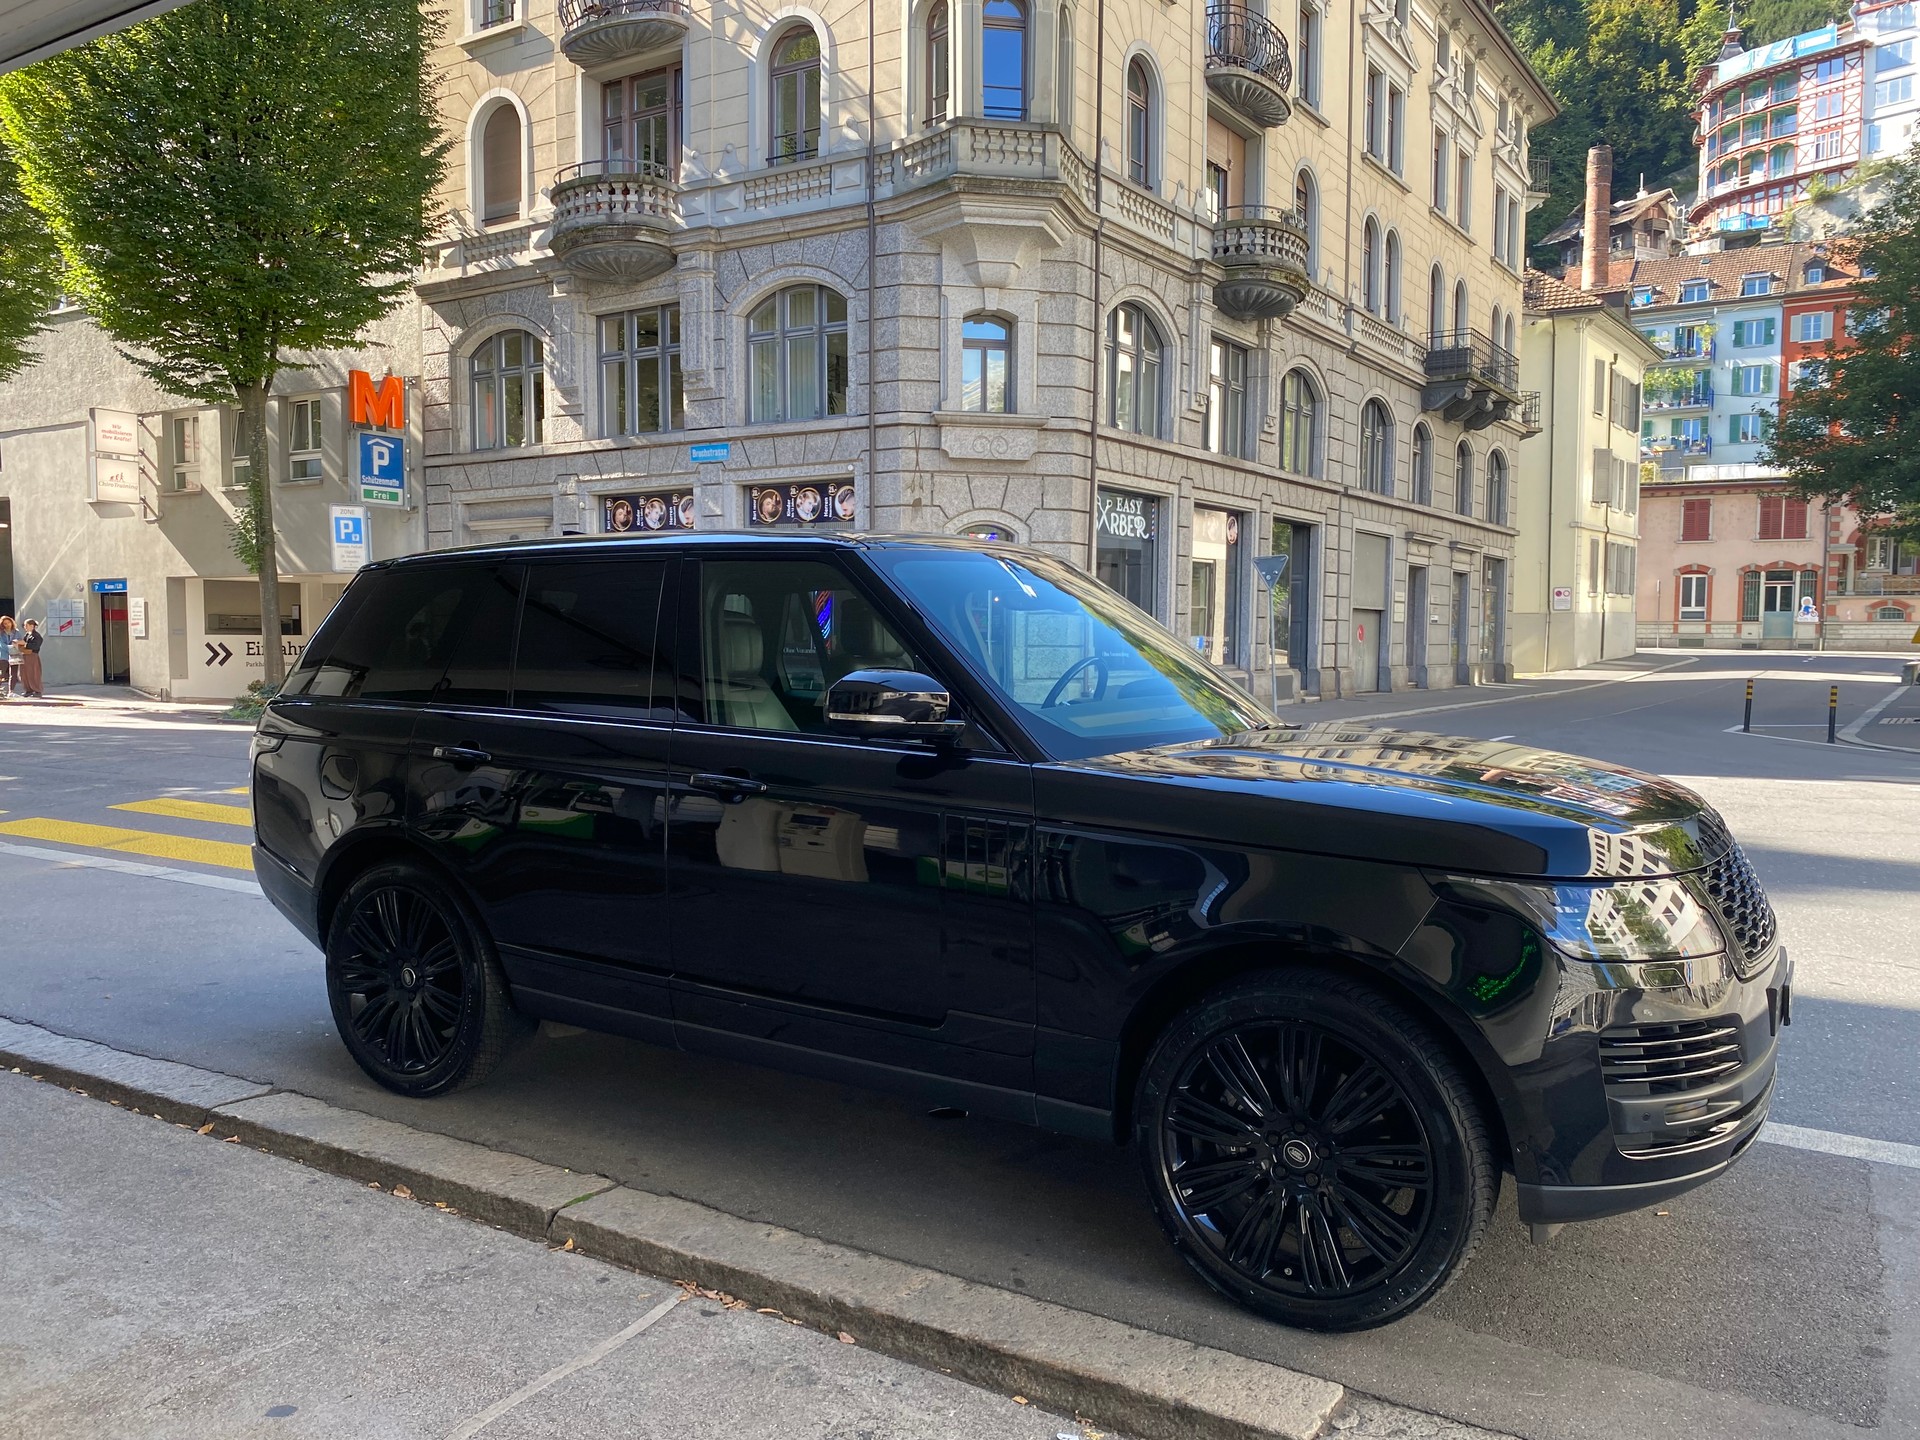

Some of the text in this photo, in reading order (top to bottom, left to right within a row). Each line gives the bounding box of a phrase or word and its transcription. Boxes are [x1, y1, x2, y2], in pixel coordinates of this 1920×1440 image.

[348, 370, 404, 429] M
[101, 429, 132, 437] mobilisieren
[361, 475, 400, 487] Schützenmatte
[372, 491, 390, 500] Frei
[1116, 497, 1143, 515] EASY
